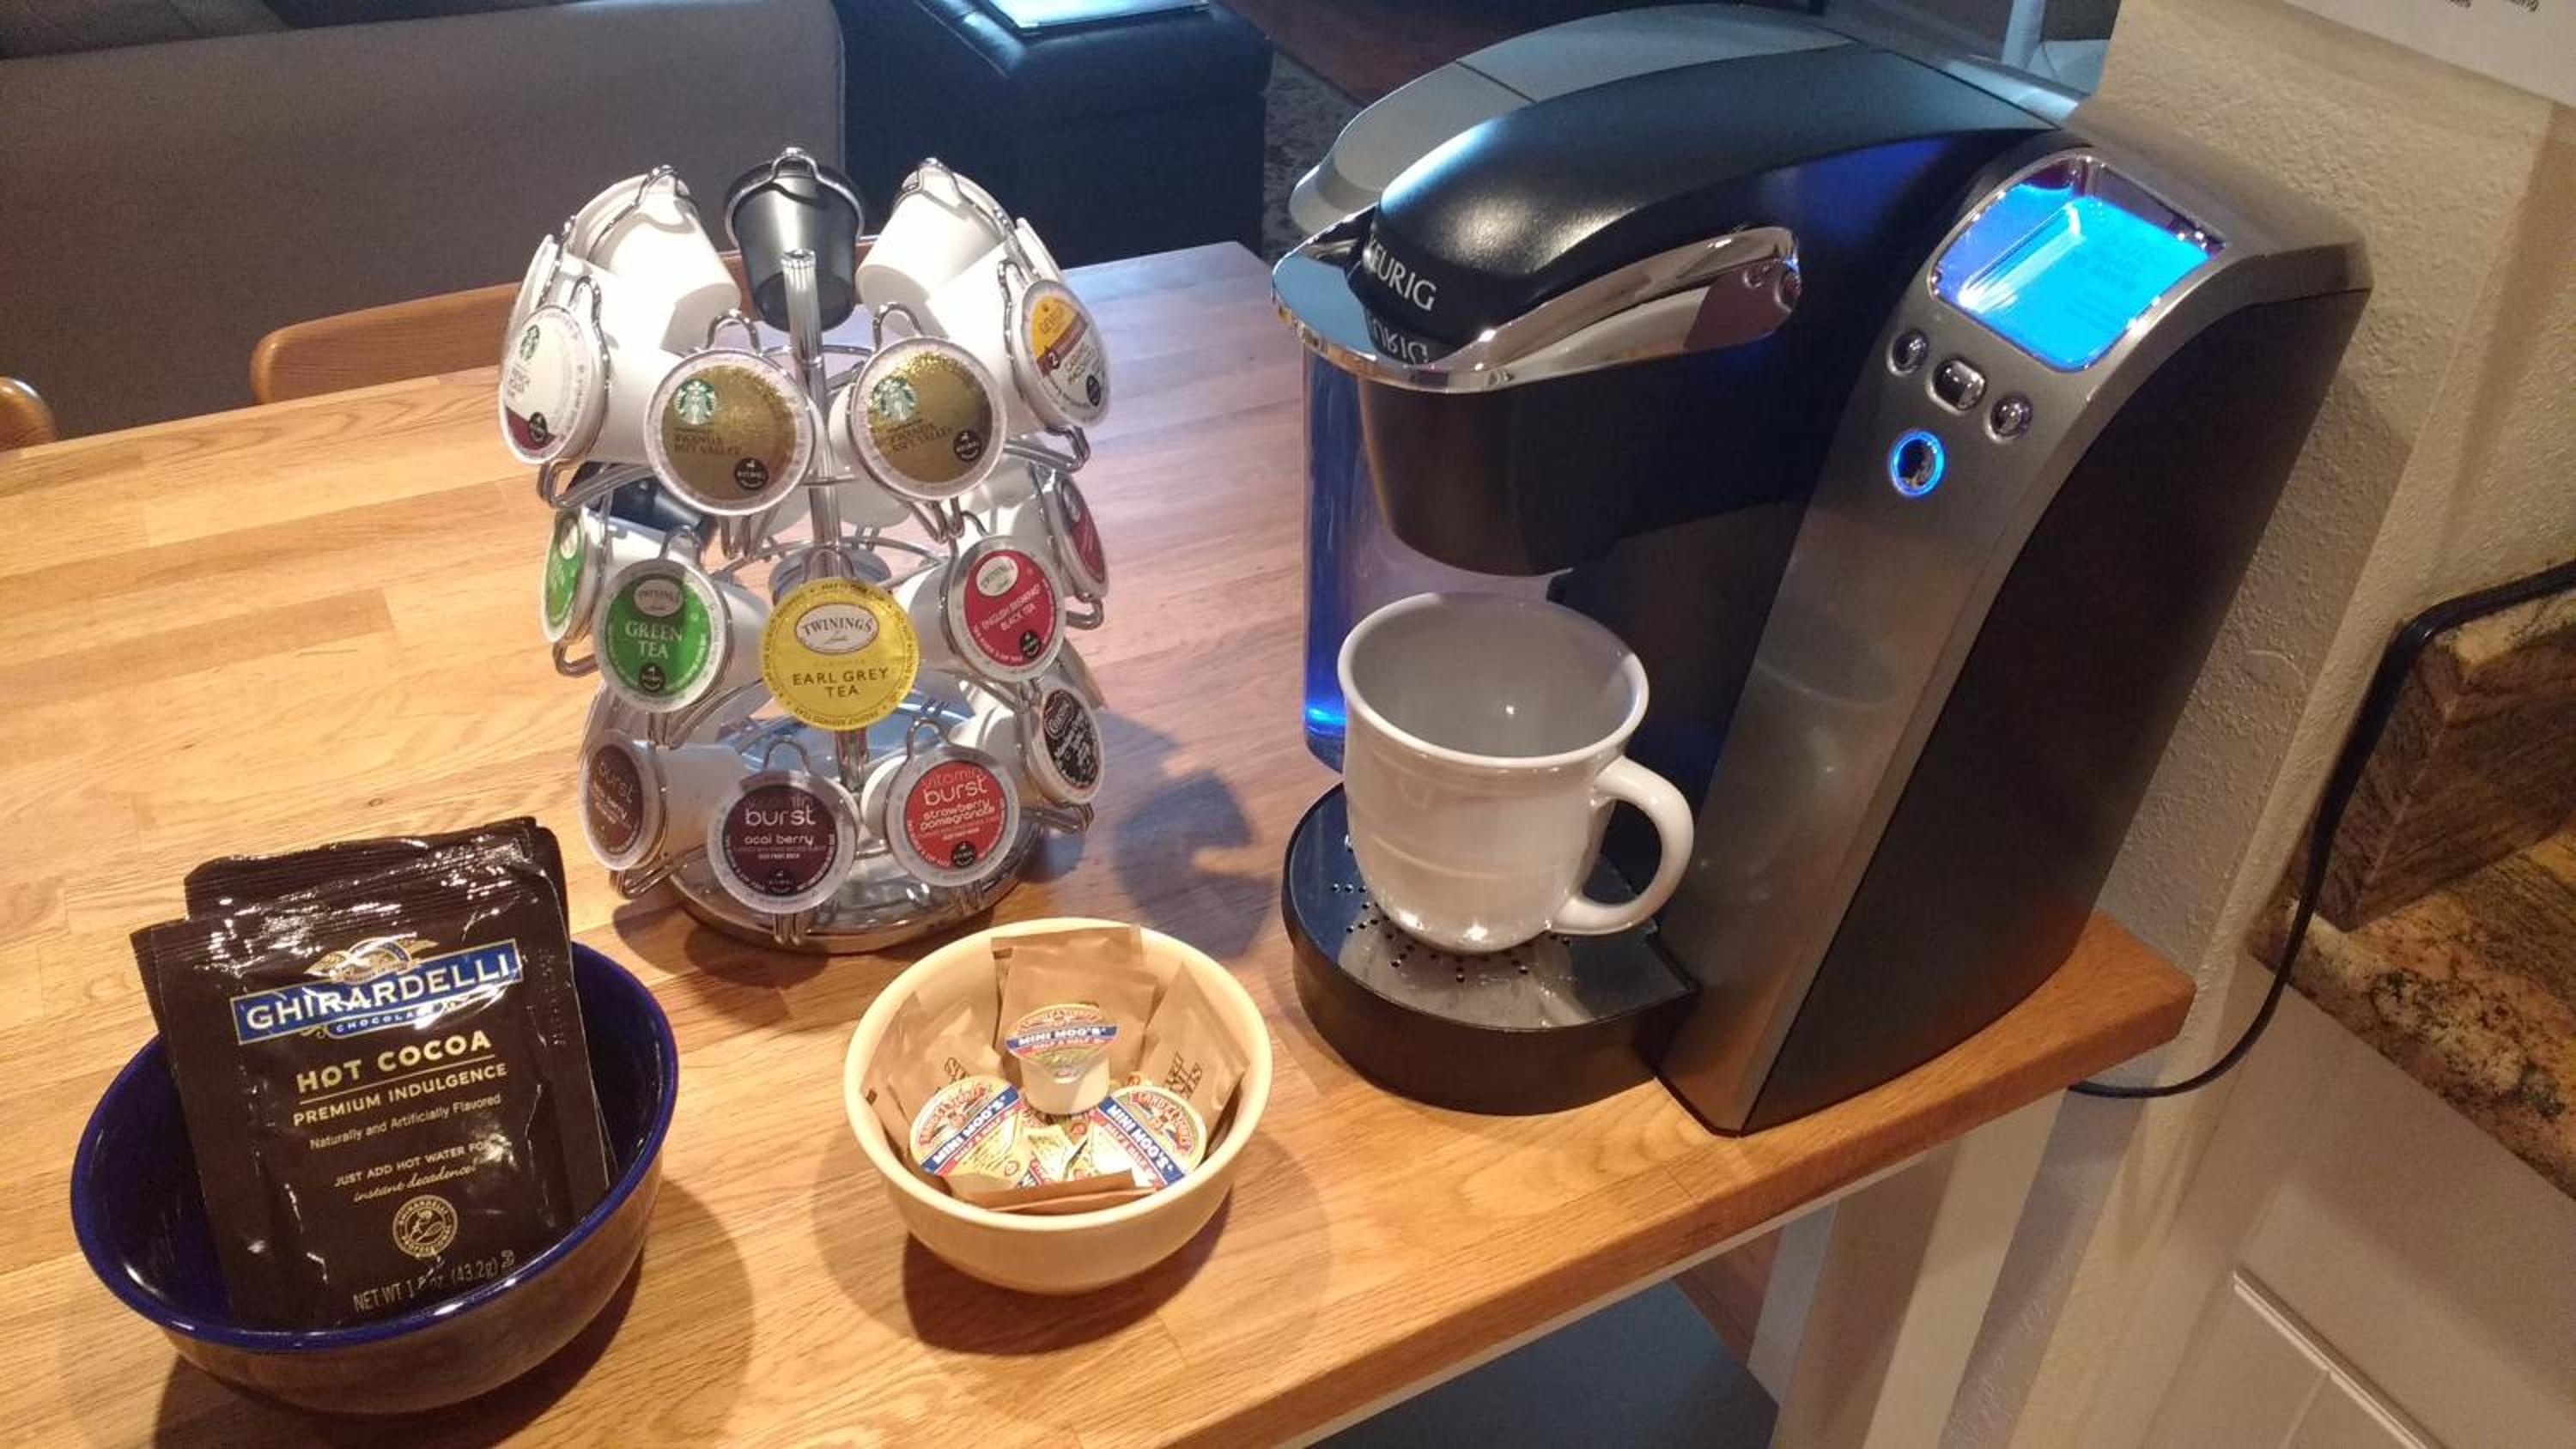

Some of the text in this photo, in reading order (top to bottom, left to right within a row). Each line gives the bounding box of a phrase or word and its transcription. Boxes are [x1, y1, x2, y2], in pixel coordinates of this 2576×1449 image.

[1048, 351, 1058, 367] 2
[800, 616, 874, 636] TWININGS
[1000, 603, 1036, 631] BLACK TEA
[624, 621, 683, 641] GREEN
[637, 640, 669, 660] TEA
[793, 667, 889, 687] EARL GREY
[825, 684, 860, 699] TEA
[923, 774, 987, 806] burst
[745, 805, 817, 826] burst
[920, 806, 995, 832] pomegranate
[923, 798, 990, 821] strawberry
[744, 834, 814, 846] acai berry
[246, 953, 512, 1030] GHIRARDELLI
[336, 1007, 436, 1033] CHOCOLA
[1018, 1032, 1052, 1046] MINI
[296, 1029, 492, 1094] HOT COCOA
[293, 1062, 508, 1127] PREMIUM INDULGENCE
[310, 1092, 501, 1150] Naturally and Artificially Flavored
[933, 1136, 964, 1165] MINI
[963, 1100, 1005, 1137] MOO'S
[1106, 1104, 1170, 1168] MINI MOO'S
[334, 1138, 492, 1188] JUST ADD HOT WATER FO
[354, 1180, 406, 1203] instant
[353, 1288, 380, 1313] NET
[380, 1282, 403, 1303] WT
